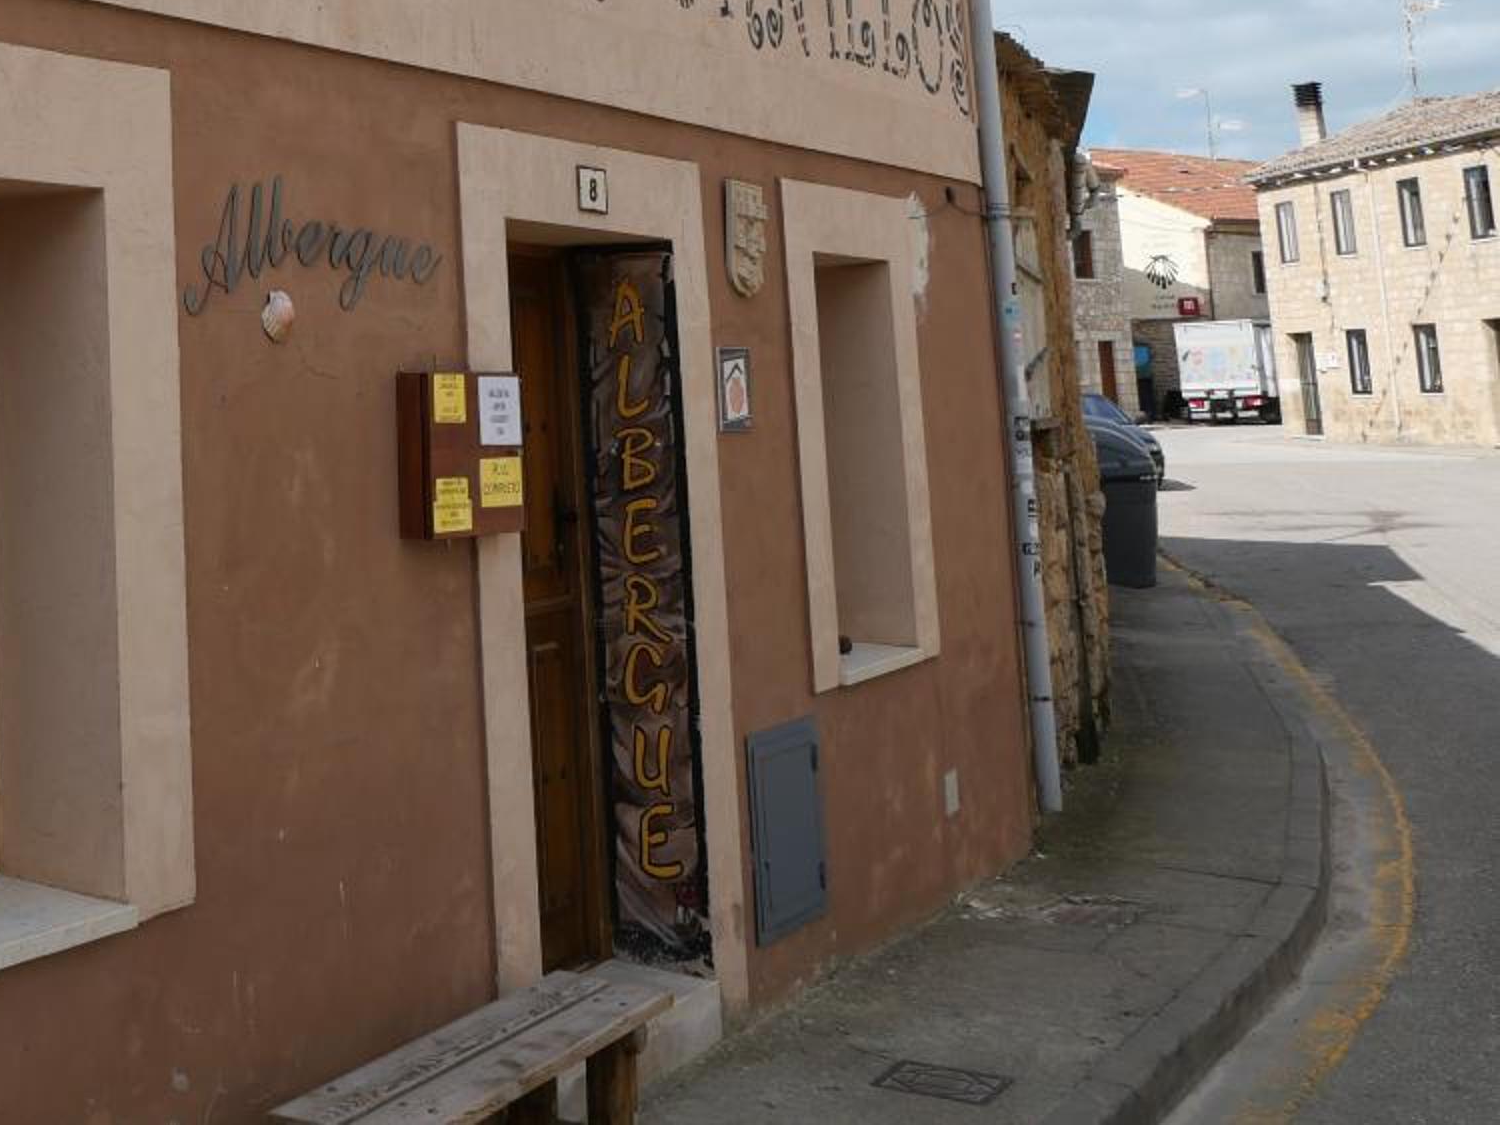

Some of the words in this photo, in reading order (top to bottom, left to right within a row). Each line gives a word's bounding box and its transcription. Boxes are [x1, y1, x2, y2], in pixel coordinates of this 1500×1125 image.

[183, 174, 444, 317] Albergue
[589, 178, 598, 202] 8
[610, 280, 684, 881] ALBERGUE
